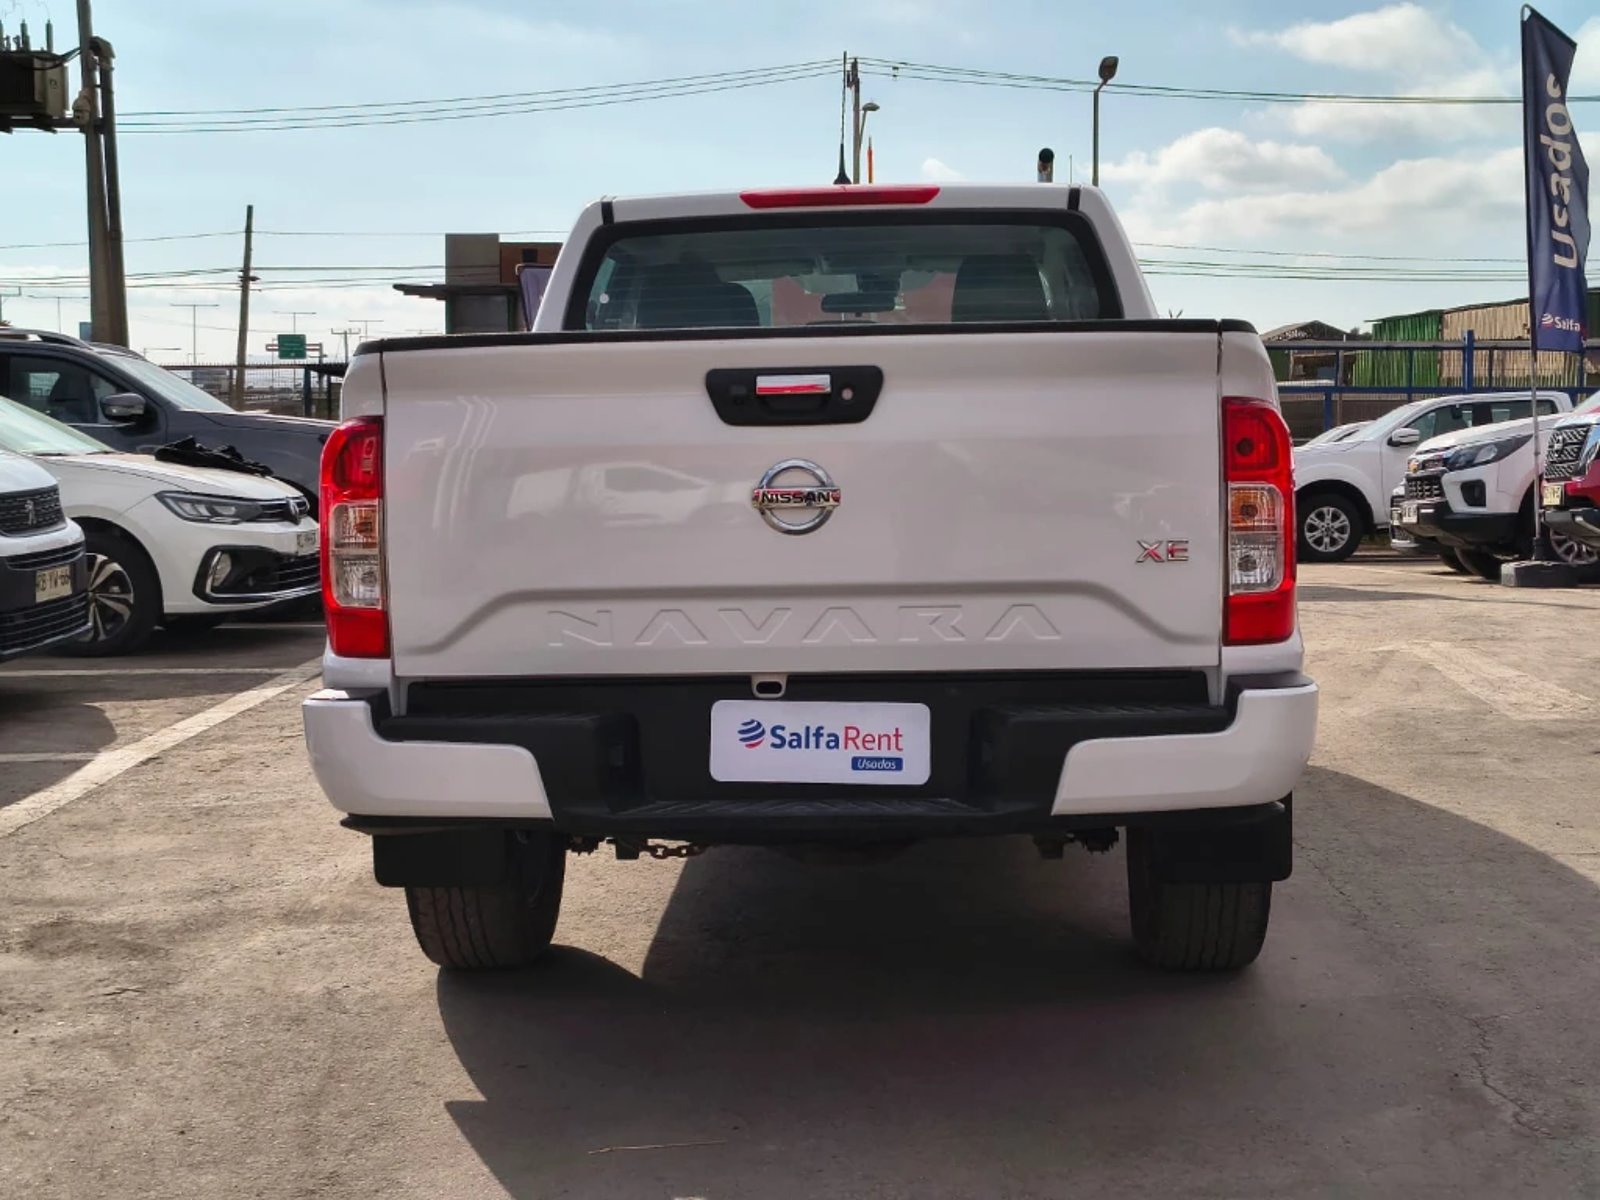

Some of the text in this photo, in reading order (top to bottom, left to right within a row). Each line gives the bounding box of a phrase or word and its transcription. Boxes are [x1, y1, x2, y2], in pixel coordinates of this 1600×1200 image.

[1540, 73, 1577, 269] Usados
[761, 490, 831, 504] NISSAN
[1135, 540, 1189, 563] XE
[547, 604, 1062, 646] NAVARA
[857, 758, 897, 770] Usados
